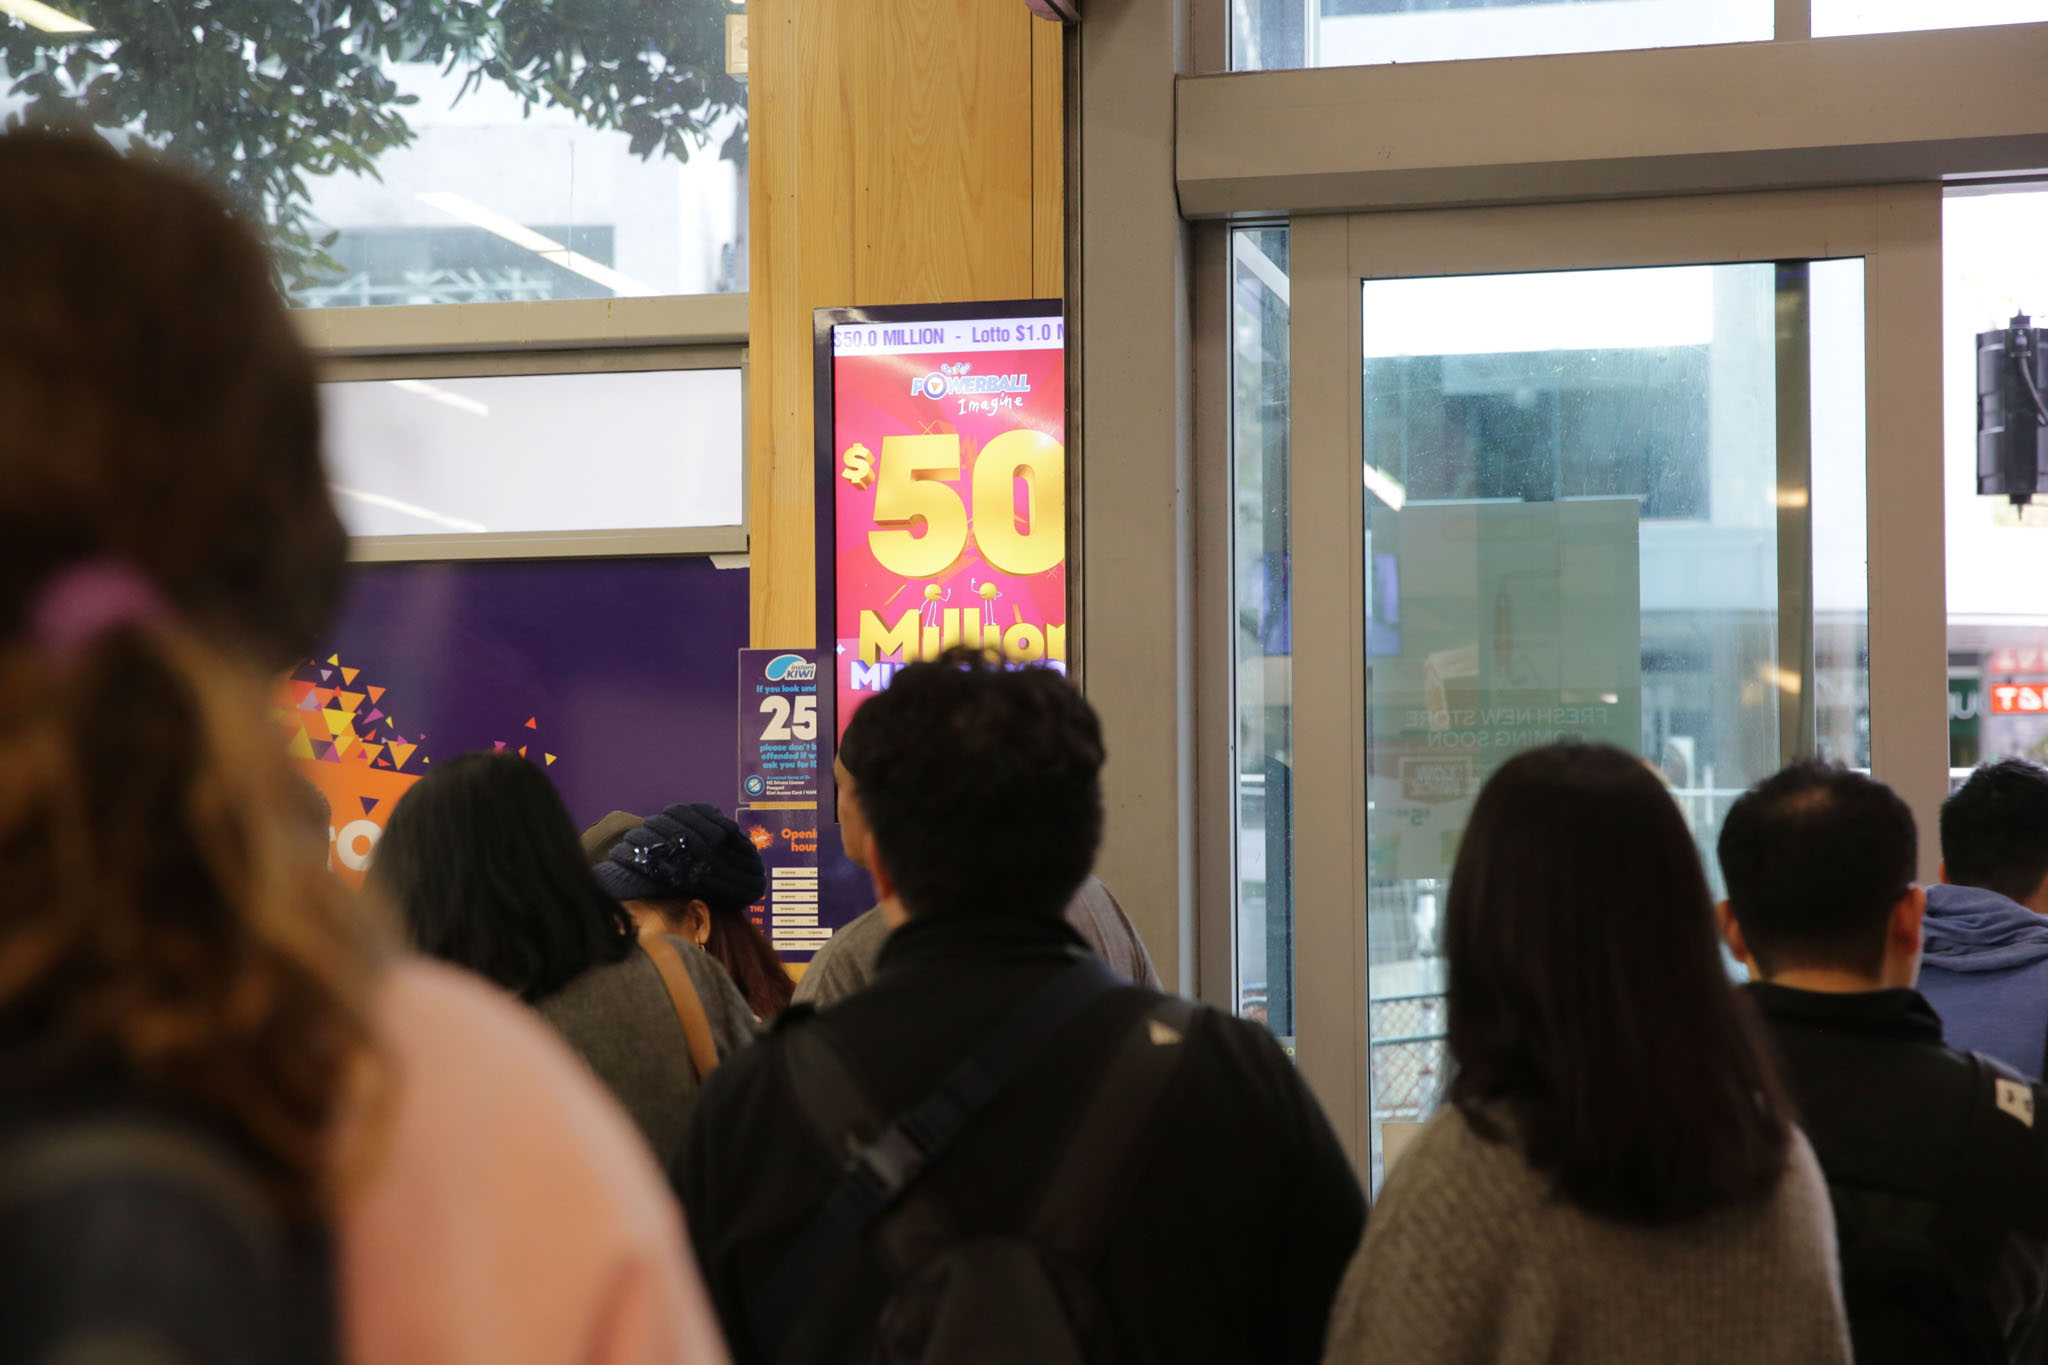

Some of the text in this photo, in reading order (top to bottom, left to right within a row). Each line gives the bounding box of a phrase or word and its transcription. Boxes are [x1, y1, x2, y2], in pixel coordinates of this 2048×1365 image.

[883, 328, 944, 346] MILLION
[972, 326, 1010, 343] Lotto
[1016, 323, 1051, 342] $1.0
[911, 372, 1031, 400] POWERBALL
[958, 392, 1024, 416] Imagine
[787, 670, 814, 679] KIWI
[765, 686, 780, 694] you
[760, 695, 817, 740] 25
[760, 744, 786, 752] please
[761, 752, 799, 760] offended
